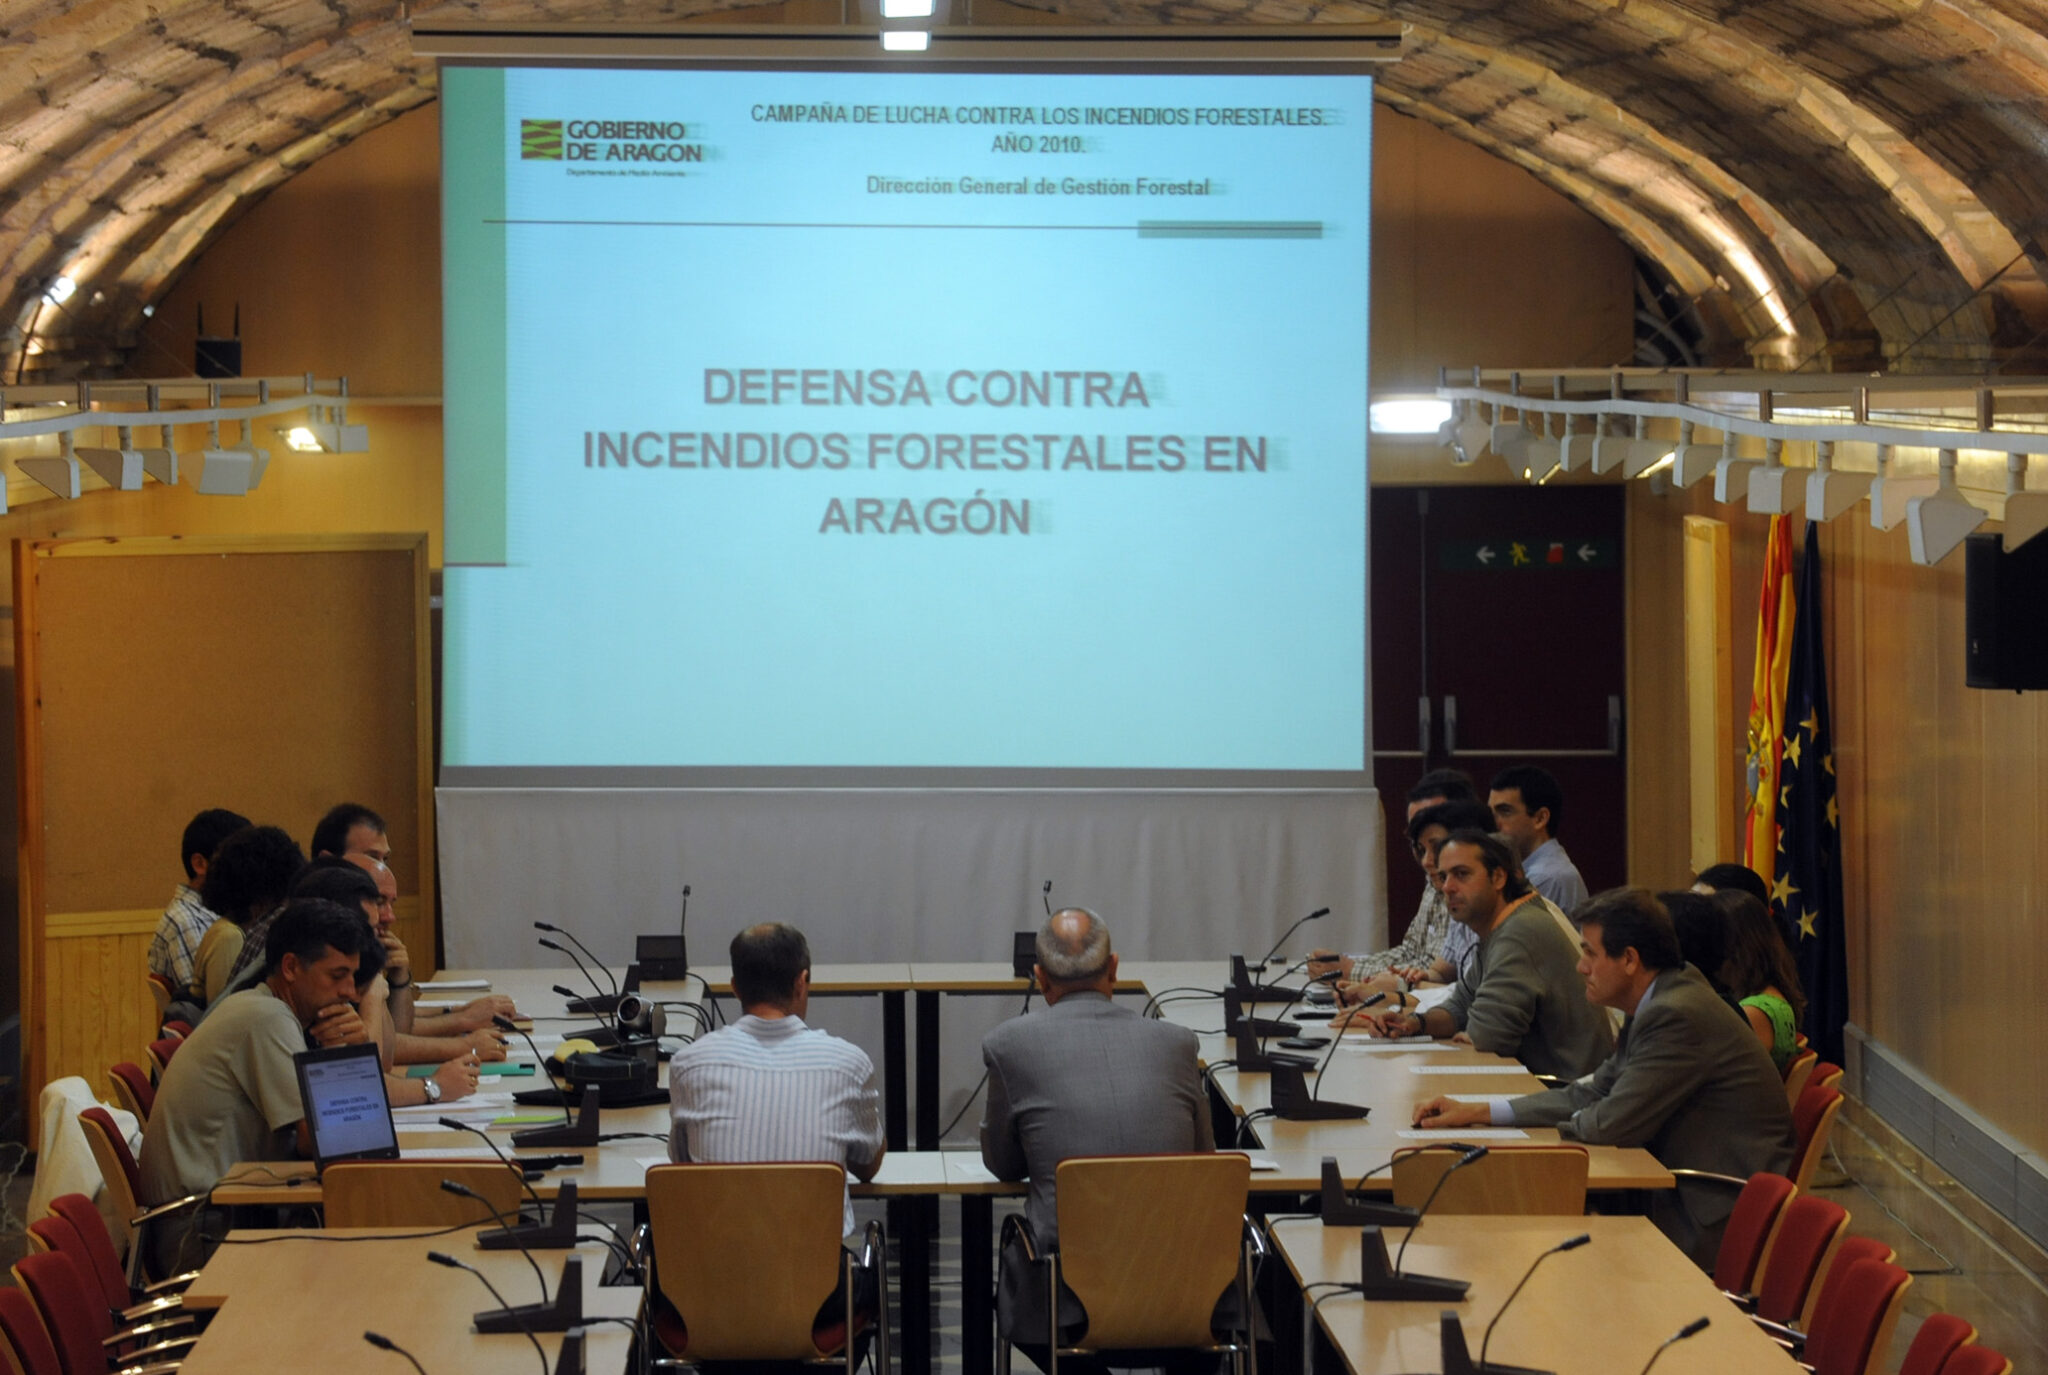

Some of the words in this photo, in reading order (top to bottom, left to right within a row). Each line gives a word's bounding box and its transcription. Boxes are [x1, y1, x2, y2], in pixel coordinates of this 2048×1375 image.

[751, 101, 847, 123] CAMPAÑA
[853, 105, 879, 124] DE
[885, 105, 950, 124] LUCHA
[956, 106, 1035, 125] CONTRA
[1042, 107, 1079, 125] LOS
[1085, 107, 1190, 126] INCENDIOS
[1195, 108, 1328, 126] FORESTALES.
[567, 120, 686, 140] GOBIERNO
[566, 143, 597, 161] DE
[605, 144, 702, 162] ARAGON
[991, 131, 1033, 153] AÑO
[867, 175, 952, 194] Dirección
[959, 176, 1028, 195] General
[1034, 177, 1056, 195] de
[1061, 177, 1130, 196] Gestión
[1136, 177, 1211, 196] Forestal
[704, 368, 932, 406] DEFENSA
[946, 369, 1151, 408] CONTRA
[584, 431, 851, 470] INCENDIOS
[868, 433, 1187, 472] FORESTALES
[1204, 436, 1267, 473] EN
[818, 488, 1030, 536] ARAGÓN
